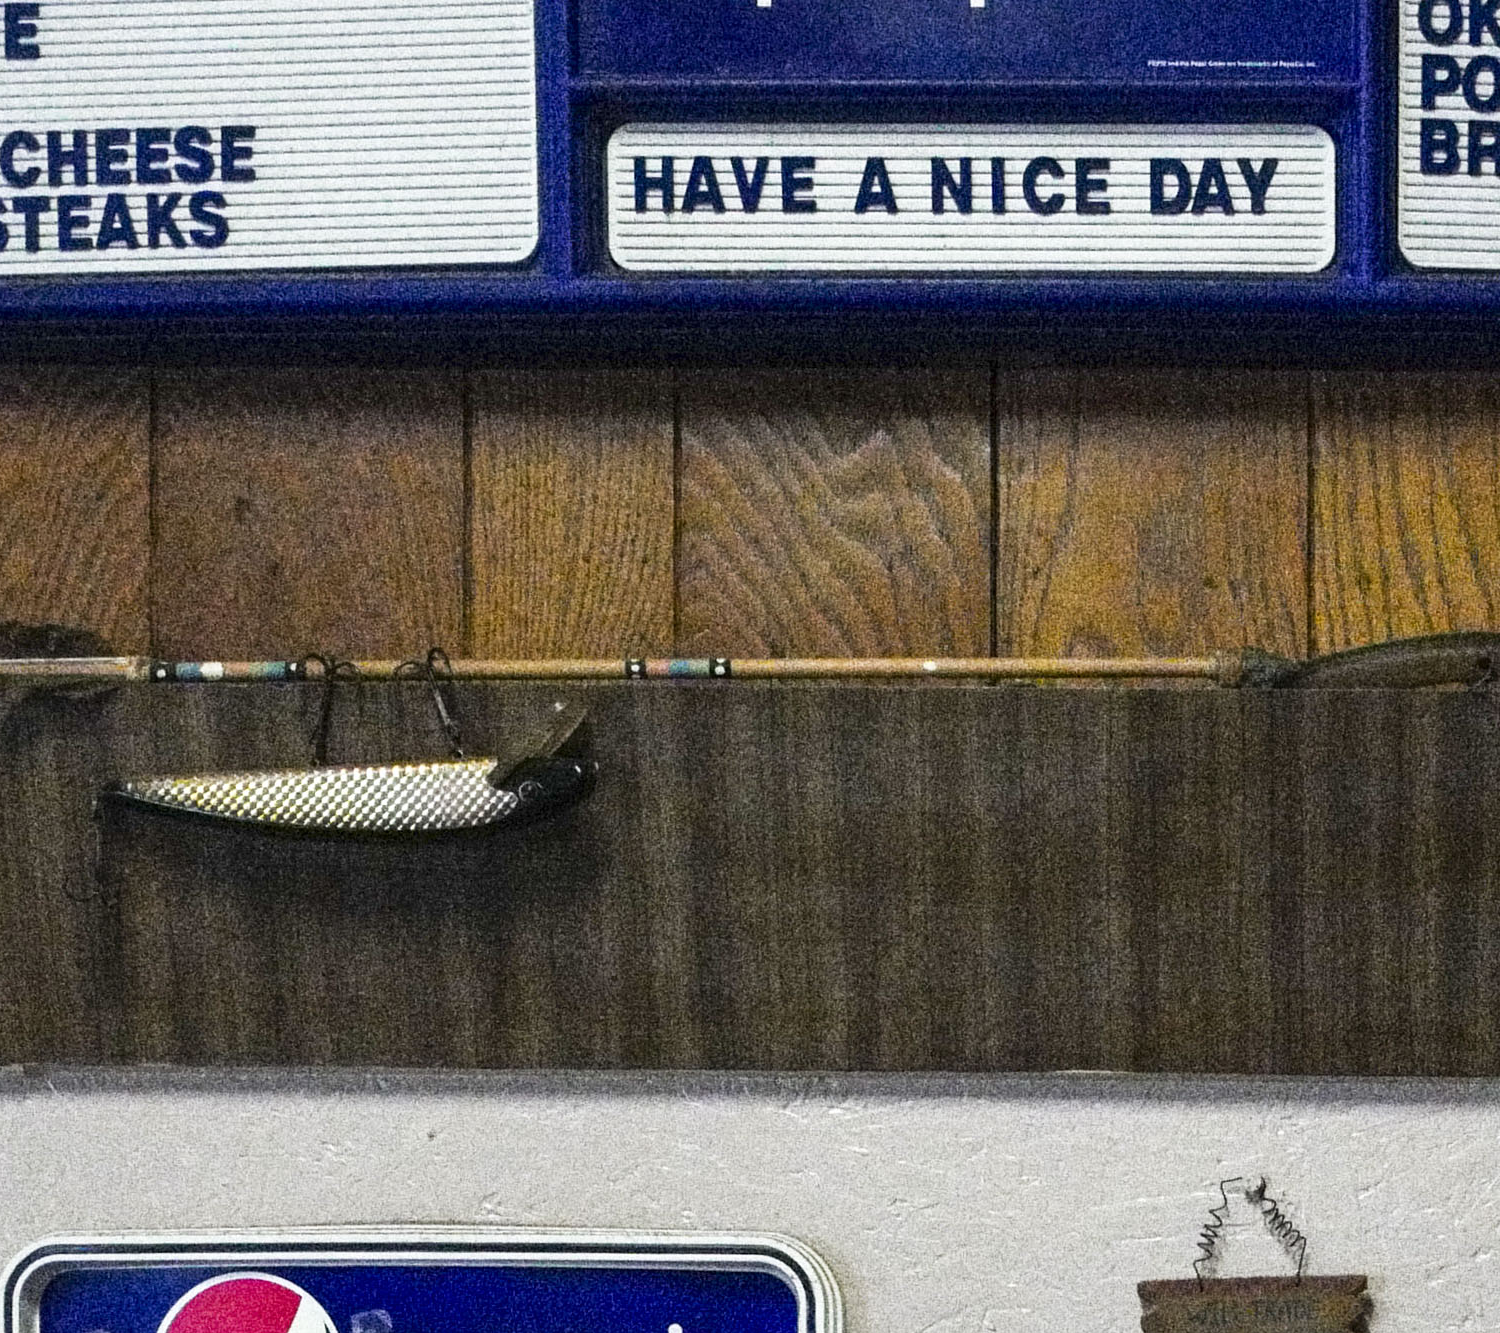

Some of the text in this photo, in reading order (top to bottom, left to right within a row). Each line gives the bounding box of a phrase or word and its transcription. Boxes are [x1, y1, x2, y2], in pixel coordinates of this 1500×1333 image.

[0, 125, 258, 190] CHEESE
[632, 154, 1279, 218] HAVE A NICE DAY
